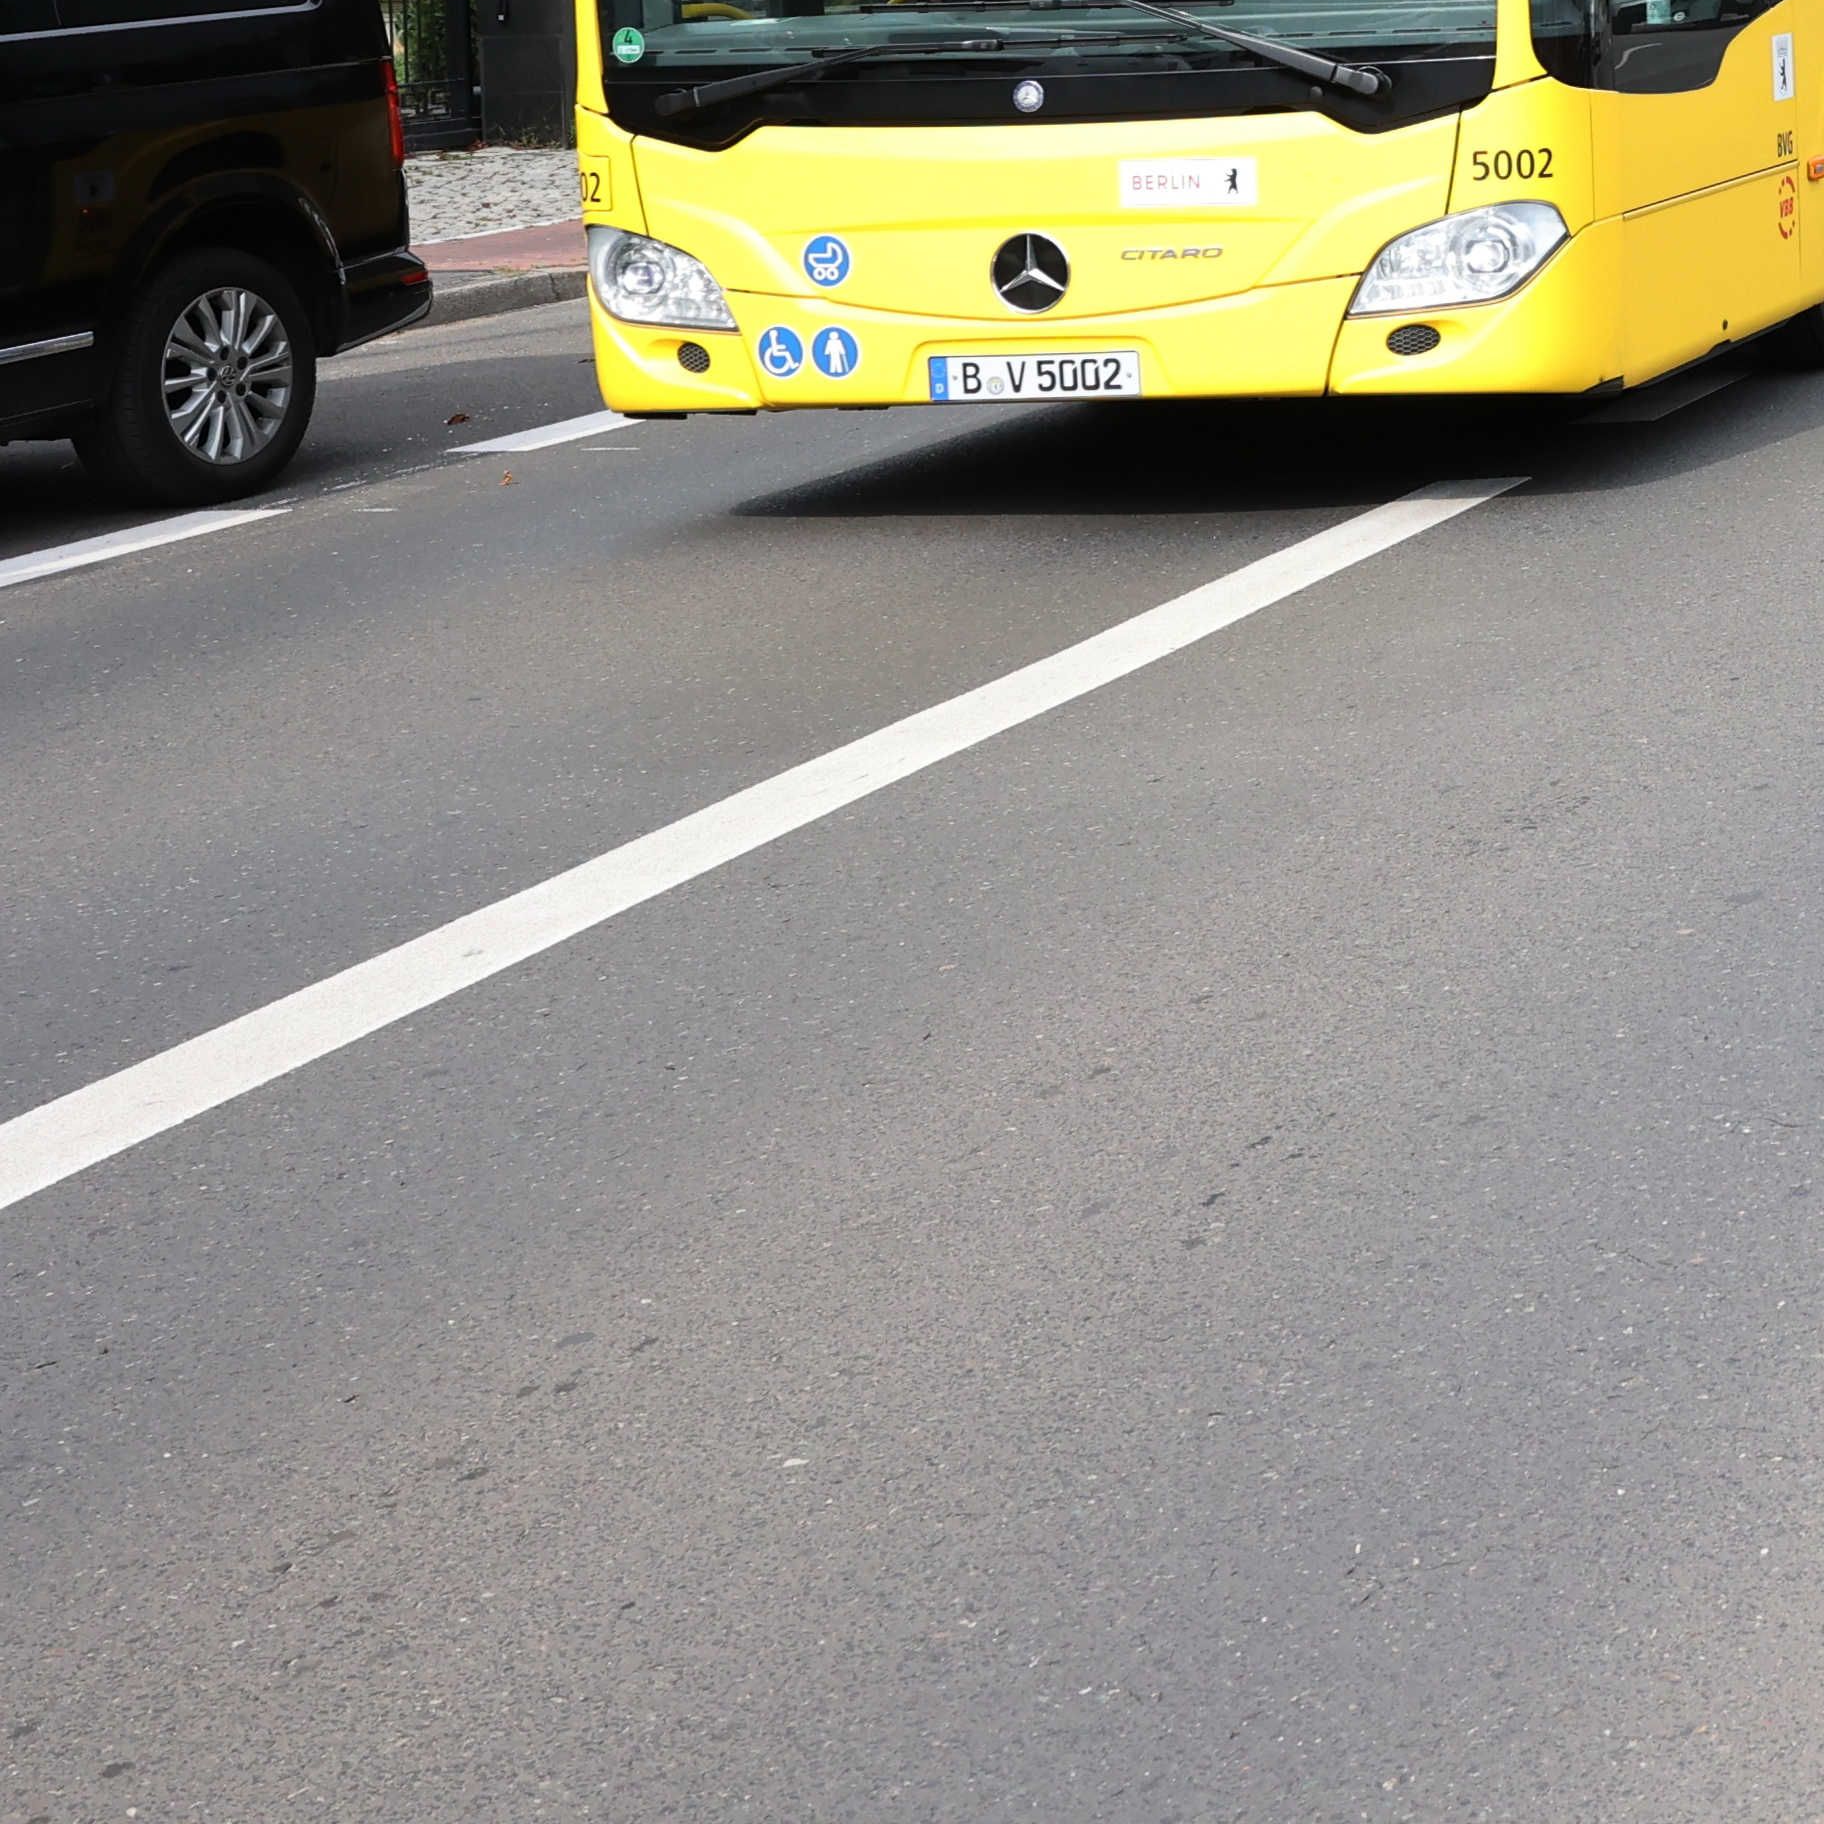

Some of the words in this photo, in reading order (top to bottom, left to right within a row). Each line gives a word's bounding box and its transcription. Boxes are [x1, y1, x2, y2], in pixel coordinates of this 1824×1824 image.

[1777, 130, 1793, 158] BVG
[1472, 147, 1554, 182] 5002
[1131, 174, 1201, 191] BERLIN
[1121, 247, 1224, 261] CITARO
[962, 362, 982, 394] B
[1006, 361, 1026, 393] V
[1036, 358, 1123, 392] 5002
